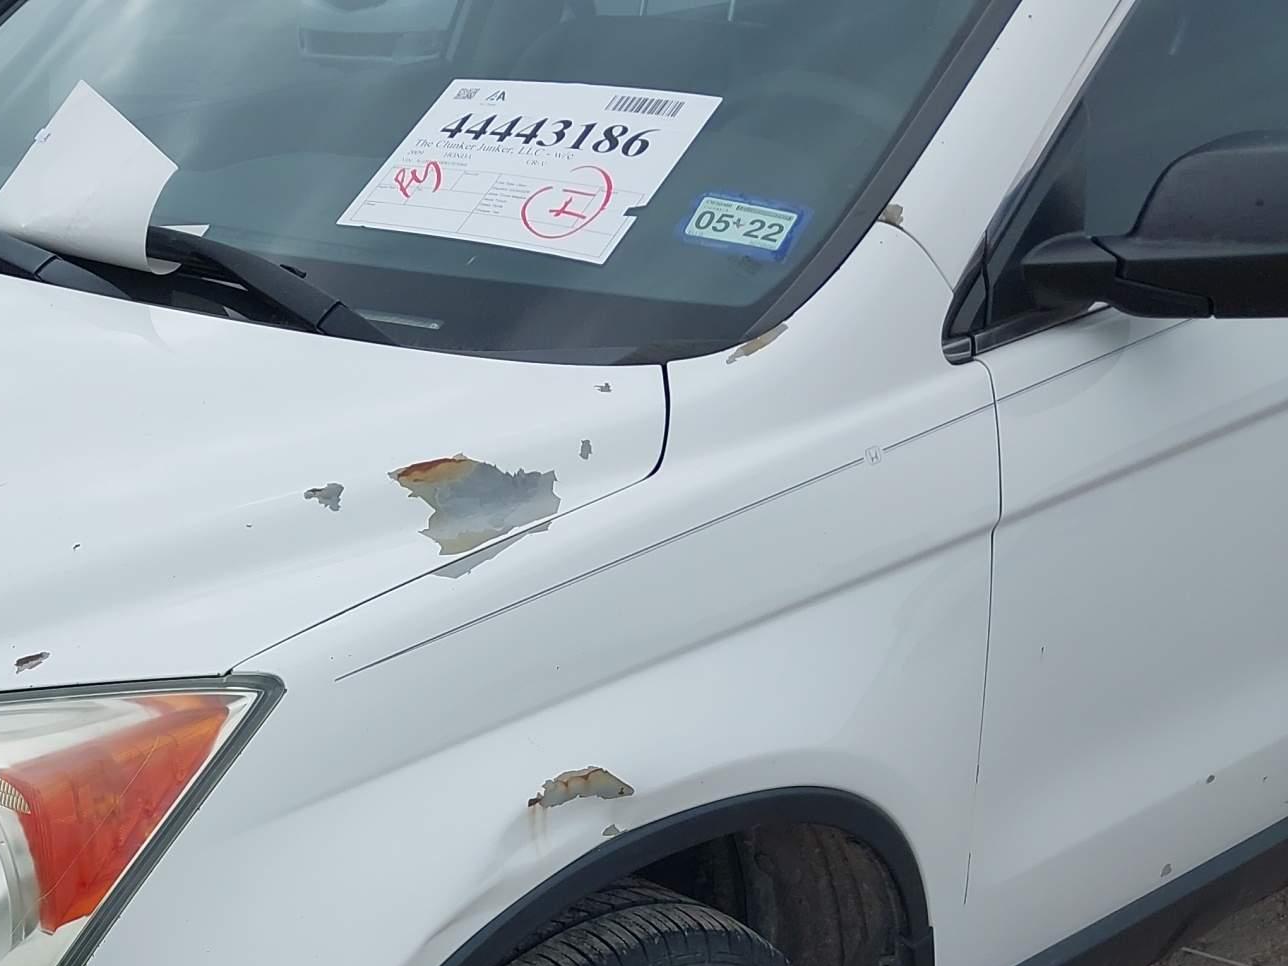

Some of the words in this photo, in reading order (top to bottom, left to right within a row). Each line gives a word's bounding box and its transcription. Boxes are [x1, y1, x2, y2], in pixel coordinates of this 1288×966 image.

[415, 138, 434, 148] The
[435, 139, 476, 151] Clunker
[518, 146, 546, 157] LLC
[439, 112, 661, 158] 44443186
[694, 210, 735, 233] 05
[742, 219, 785, 243] 22
